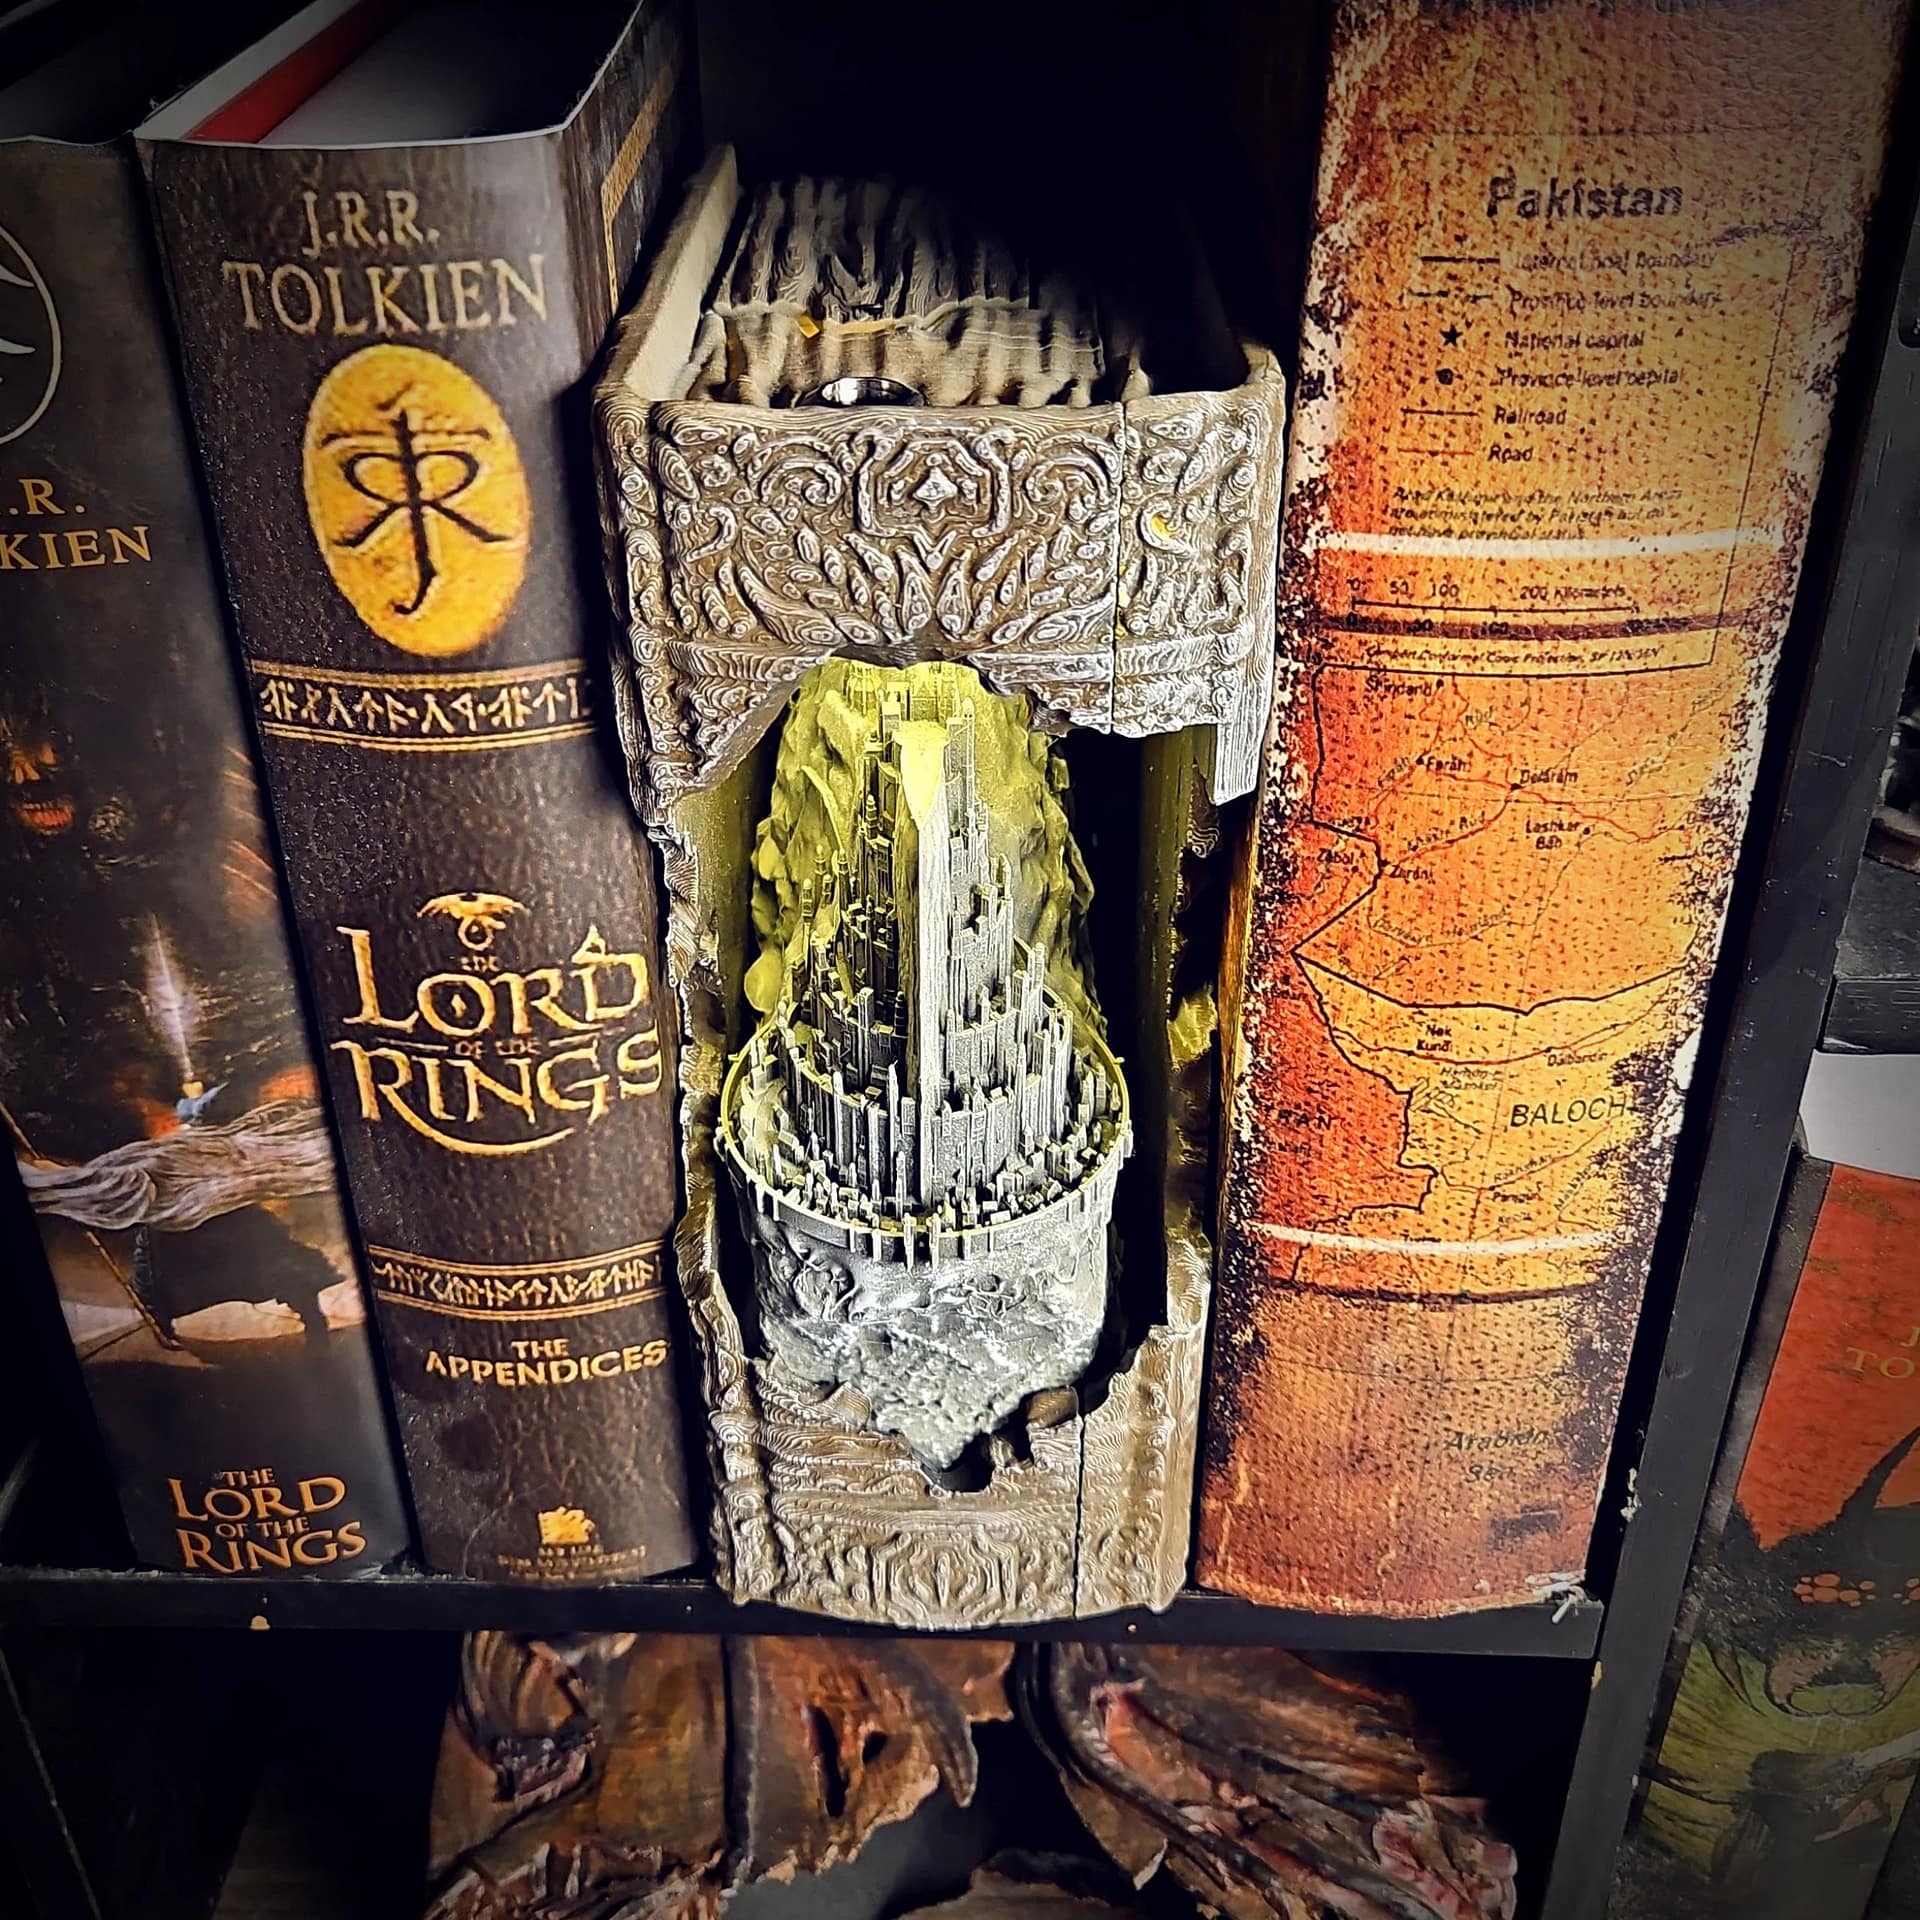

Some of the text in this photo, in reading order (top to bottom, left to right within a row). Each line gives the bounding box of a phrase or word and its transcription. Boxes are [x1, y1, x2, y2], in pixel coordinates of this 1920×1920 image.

[1487, 176, 1683, 221] Pakistan
[302, 190, 440, 258] J.R.R.
[221, 254, 545, 336] TOLKIEN
[1493, 405, 1567, 426] Railroad
[1430, 583, 1460, 598] 100
[1520, 585, 1549, 601] 200
[336, 924, 649, 1037] LORD
[330, 1016, 663, 1156] RINGS
[425, 1338, 669, 1388] APPENDICES
[511, 1338, 569, 1361] THE
[167, 1475, 347, 1522] LORD
[221, 1467, 276, 1487] THE
[175, 1521, 368, 1575] RINGS
[214, 1516, 311, 1538] OF THE
